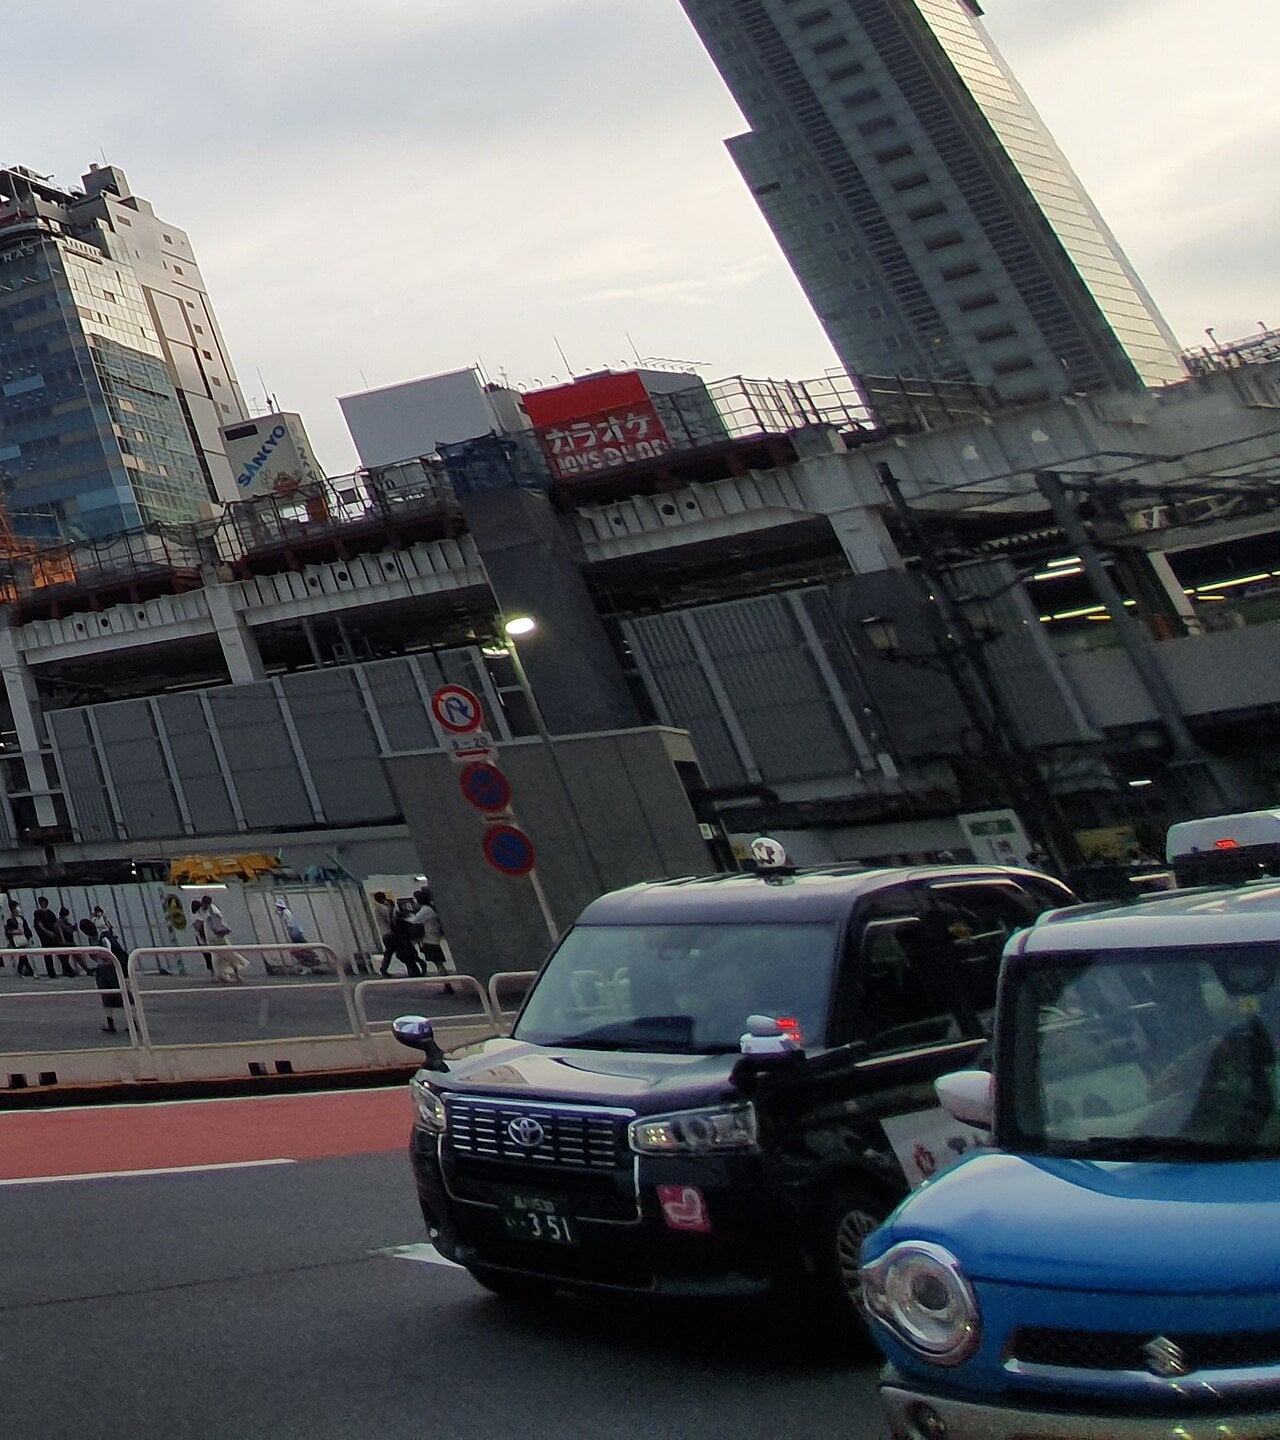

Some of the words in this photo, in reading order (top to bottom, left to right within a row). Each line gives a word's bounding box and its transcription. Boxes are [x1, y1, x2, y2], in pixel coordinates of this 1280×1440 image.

[237, 425, 286, 487] SANKYO
[544, 411, 653, 454] カラオケ
